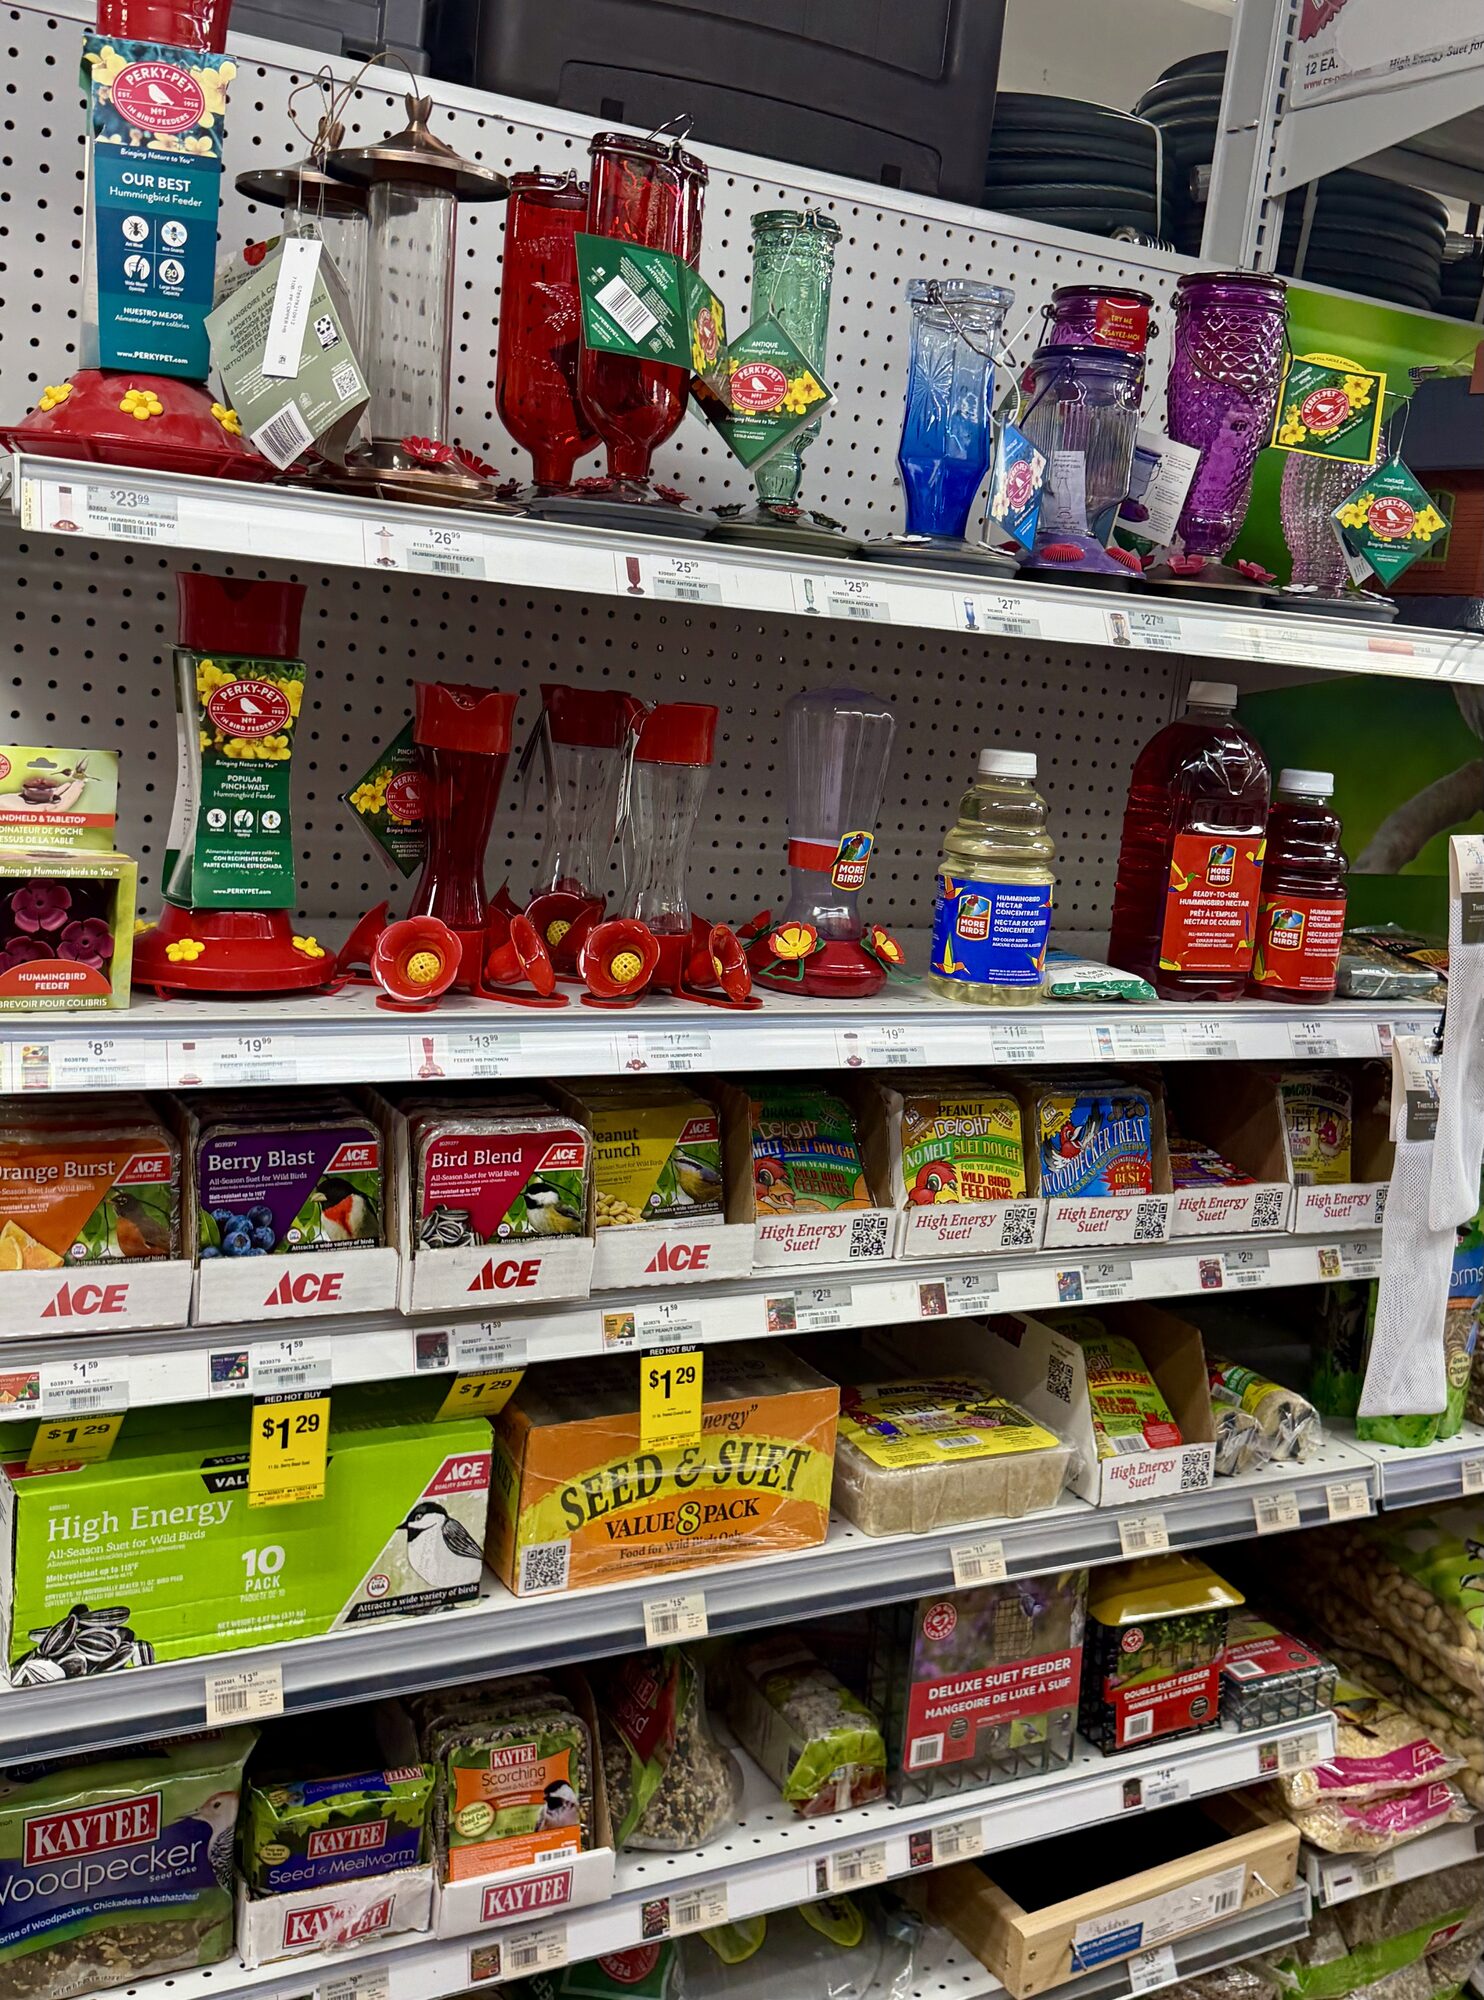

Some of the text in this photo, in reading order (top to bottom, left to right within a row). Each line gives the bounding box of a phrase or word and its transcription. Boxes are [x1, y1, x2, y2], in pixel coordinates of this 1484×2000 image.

[1304, 57, 1339, 76] 12 EA.
[157, 113, 190, 126] FEEDERS
[148, 152, 170, 162] Nature
[121, 172, 191, 192] OUR BEST
[109, 186, 202, 208] Hummingbird Feeder
[123, 307, 184, 321] NUESTRO MEJOR
[751, 341, 779, 349] ANTIQUE
[738, 366, 782, 382] PERKY-PET
[1304, 391, 1338, 413] PERKY-PET
[220, 684, 281, 703] PERKY-PET
[229, 720, 277, 732] BIRD FEEDERS
[221, 782, 270, 791] PINCH-WAIST
[227, 774, 262, 783] POPULAR
[214, 790, 276, 800] Hummingbird Feeder
[46, 815, 87, 824] TABLETOP
[55, 828, 84, 836] POCHE
[50, 837, 75, 845] TABLE
[34, 866, 89, 880] Hummingbirds
[839, 864, 865, 874] MORE
[837, 874, 863, 883] BIRDS
[1210, 874, 1230, 882] BIRDS
[1192, 890, 1240, 899] READY-TO-USE
[1225, 900, 1250, 908] NECTAR
[960, 918, 986, 928] MORE
[994, 918, 1021, 927] NECTAR
[960, 926, 985, 936] BIRDS
[1273, 930, 1299, 940] MORE
[1272, 937, 1298, 947] BIRDS
[18, 972, 87, 982] HUMMINGBIRD
[35, 982, 70, 990] FEEDER
[40, 998, 107, 1008] POUR COLIBRIS
[938, 1104, 985, 1117] PEANUT
[689, 1122, 711, 1134] ACE
[342, 1148, 369, 1162] ACE
[431, 1148, 522, 1168] Bird Blend
[552, 1148, 578, 1160] ACE
[812, 1140, 856, 1160] DOUGH
[924, 1138, 1020, 1163] MELT SUET DOUGH
[1042, 1127, 1111, 1195] WOODPECKER
[1112, 1119, 1146, 1147] TREAT
[64, 1160, 116, 1178] Burst
[133, 1160, 164, 1174] ACE
[208, 1150, 316, 1173] Berry Blast
[208, 1172, 308, 1186] All-Season Suet Wild Birds
[960, 1170, 1012, 1188] WILD BIRD
[995, 1166, 1020, 1178] ROUND
[1178, 1196, 1249, 1213] High Energy
[1306, 1193, 1372, 1207] High Energy
[1057, 1207, 1132, 1223] High Energy
[1197, 1209, 1227, 1222] Suet!
[1324, 1206, 1352, 1218] Suet!
[916, 1213, 998, 1230] High Energy
[1077, 1220, 1109, 1233] Suet!
[760, 1224, 847, 1242] High Energy
[938, 1227, 972, 1241] Suet!
[784, 1238, 821, 1252] Suet!
[644, 1241, 712, 1273] ACE
[467, 1257, 542, 1292] ACE
[264, 1270, 344, 1306] ACE
[41, 1282, 130, 1319] ACE
[650, 1345, 697, 1356] RED HOT BUY
[66, 1388, 92, 1396] ORANGE
[264, 1390, 322, 1404] RED HOT BUY
[444, 1461, 484, 1483] ACE
[1110, 1459, 1178, 1481] High Energy
[560, 1440, 812, 1532] SEED & SUET
[1128, 1474, 1157, 1491] Suet!
[48, 1500, 234, 1544] High Energy
[605, 1497, 761, 1541] VALUE 8 PACK
[48, 1530, 206, 1561] All-Season Suet for Wild Birds
[620, 1538, 691, 1561] Food Wild
[241, 1545, 286, 1577] 10
[244, 1575, 281, 1593] PACK
[358, 1600, 391, 1612] Attracts
[400, 1594, 419, 1605] wide
[420, 1591, 447, 1603] variety
[458, 1584, 478, 1596] birds
[928, 1656, 1072, 1701] DELUXE SUET FEEDER
[1123, 1668, 1211, 1701] DOUBLE SUET FEEDER
[925, 1677, 1073, 1720] MANGEOIRE DE LUXE SUIF
[493, 1746, 535, 1769] KAYTEE
[482, 1765, 546, 1787] Scorching
[460, 1816, 476, 1827] Seed
[33, 1803, 155, 1859] KAYTEE
[313, 1825, 381, 1855] KAYTEE
[150, 1866, 198, 1883] Seed Cake
[269, 1850, 415, 1885] Seed Mealworm
[487, 1876, 565, 1916] KAYTEE
[21, 1897, 142, 1935] of Woodpeckers, Chickadees
